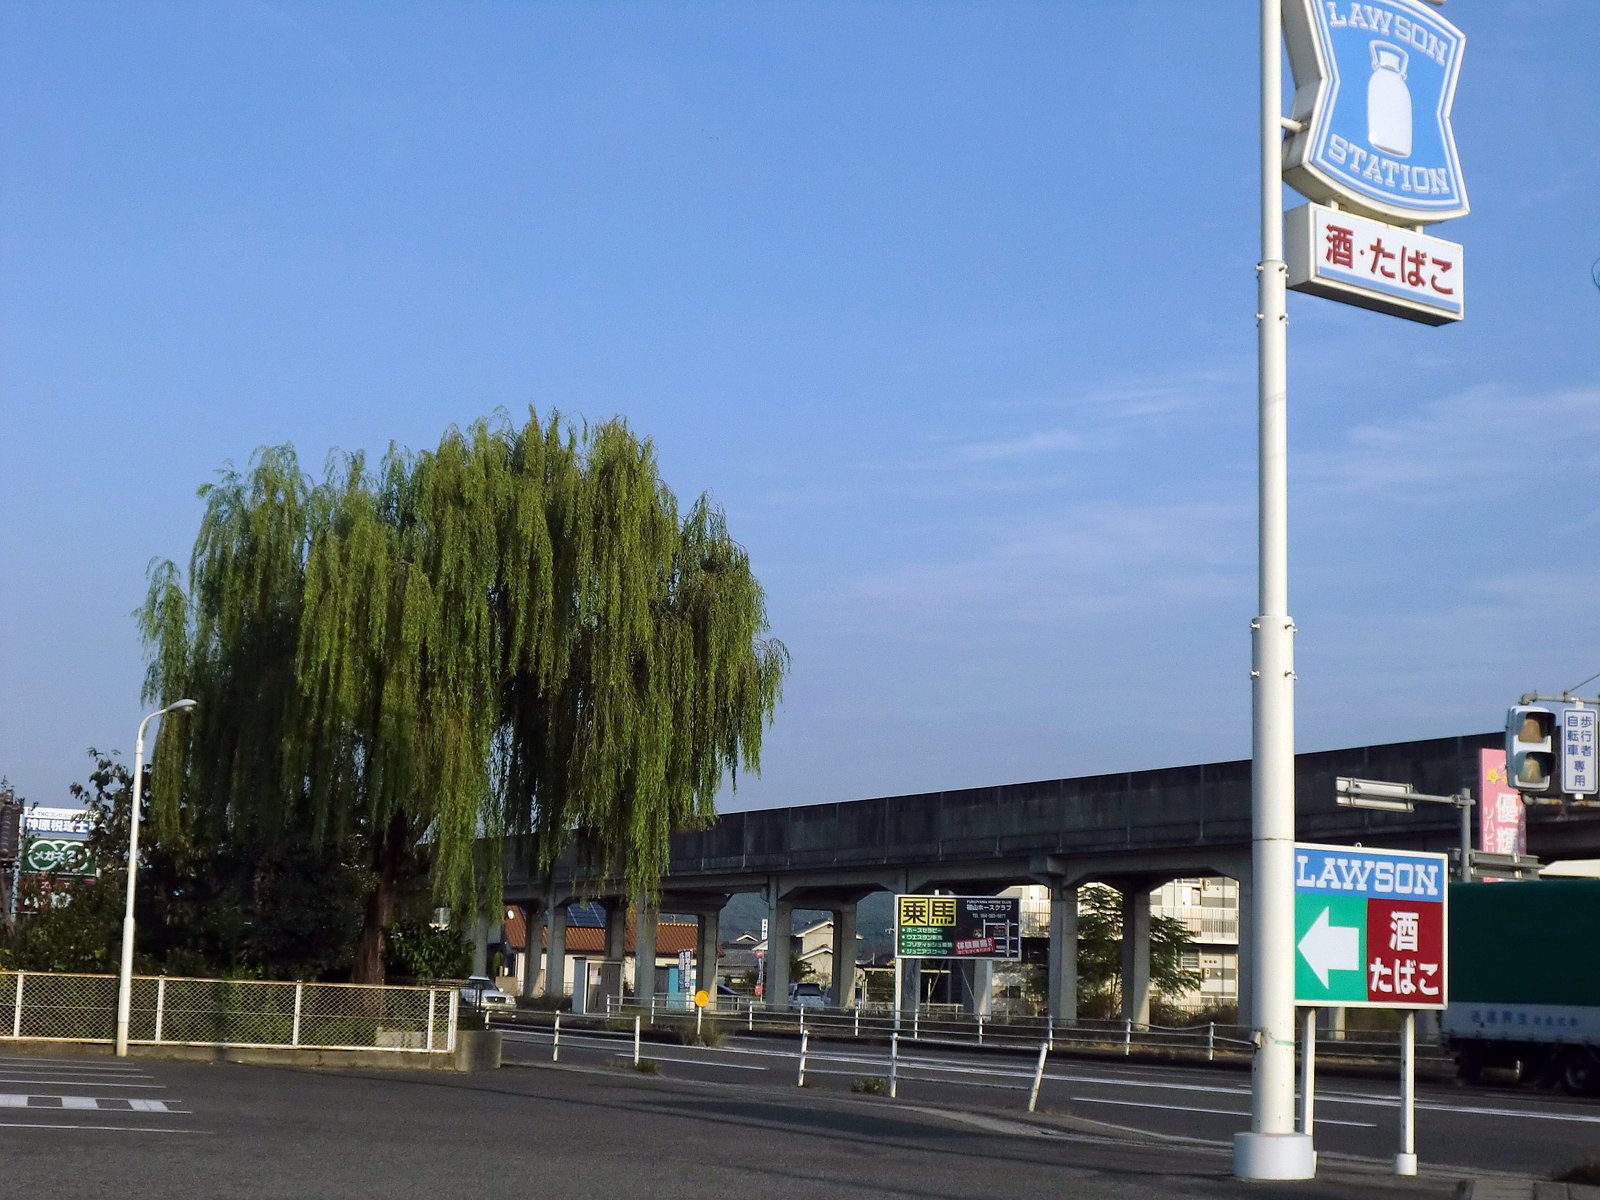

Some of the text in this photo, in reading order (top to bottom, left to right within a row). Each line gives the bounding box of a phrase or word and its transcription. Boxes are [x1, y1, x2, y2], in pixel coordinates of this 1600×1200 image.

[1327, 2, 1448, 66] LAWSON
[1328, 133, 1450, 194] STATION
[1567, 715, 1579, 755] 自転車
[1580, 715, 1593, 757] 歩行者
[1574, 760, 1586, 786] 専用
[1296, 855, 1438, 896] LAWSON
[902, 900, 955, 924] 乗馬
[1389, 911, 1419, 952] 酒
[1370, 957, 1439, 995] たばこ
